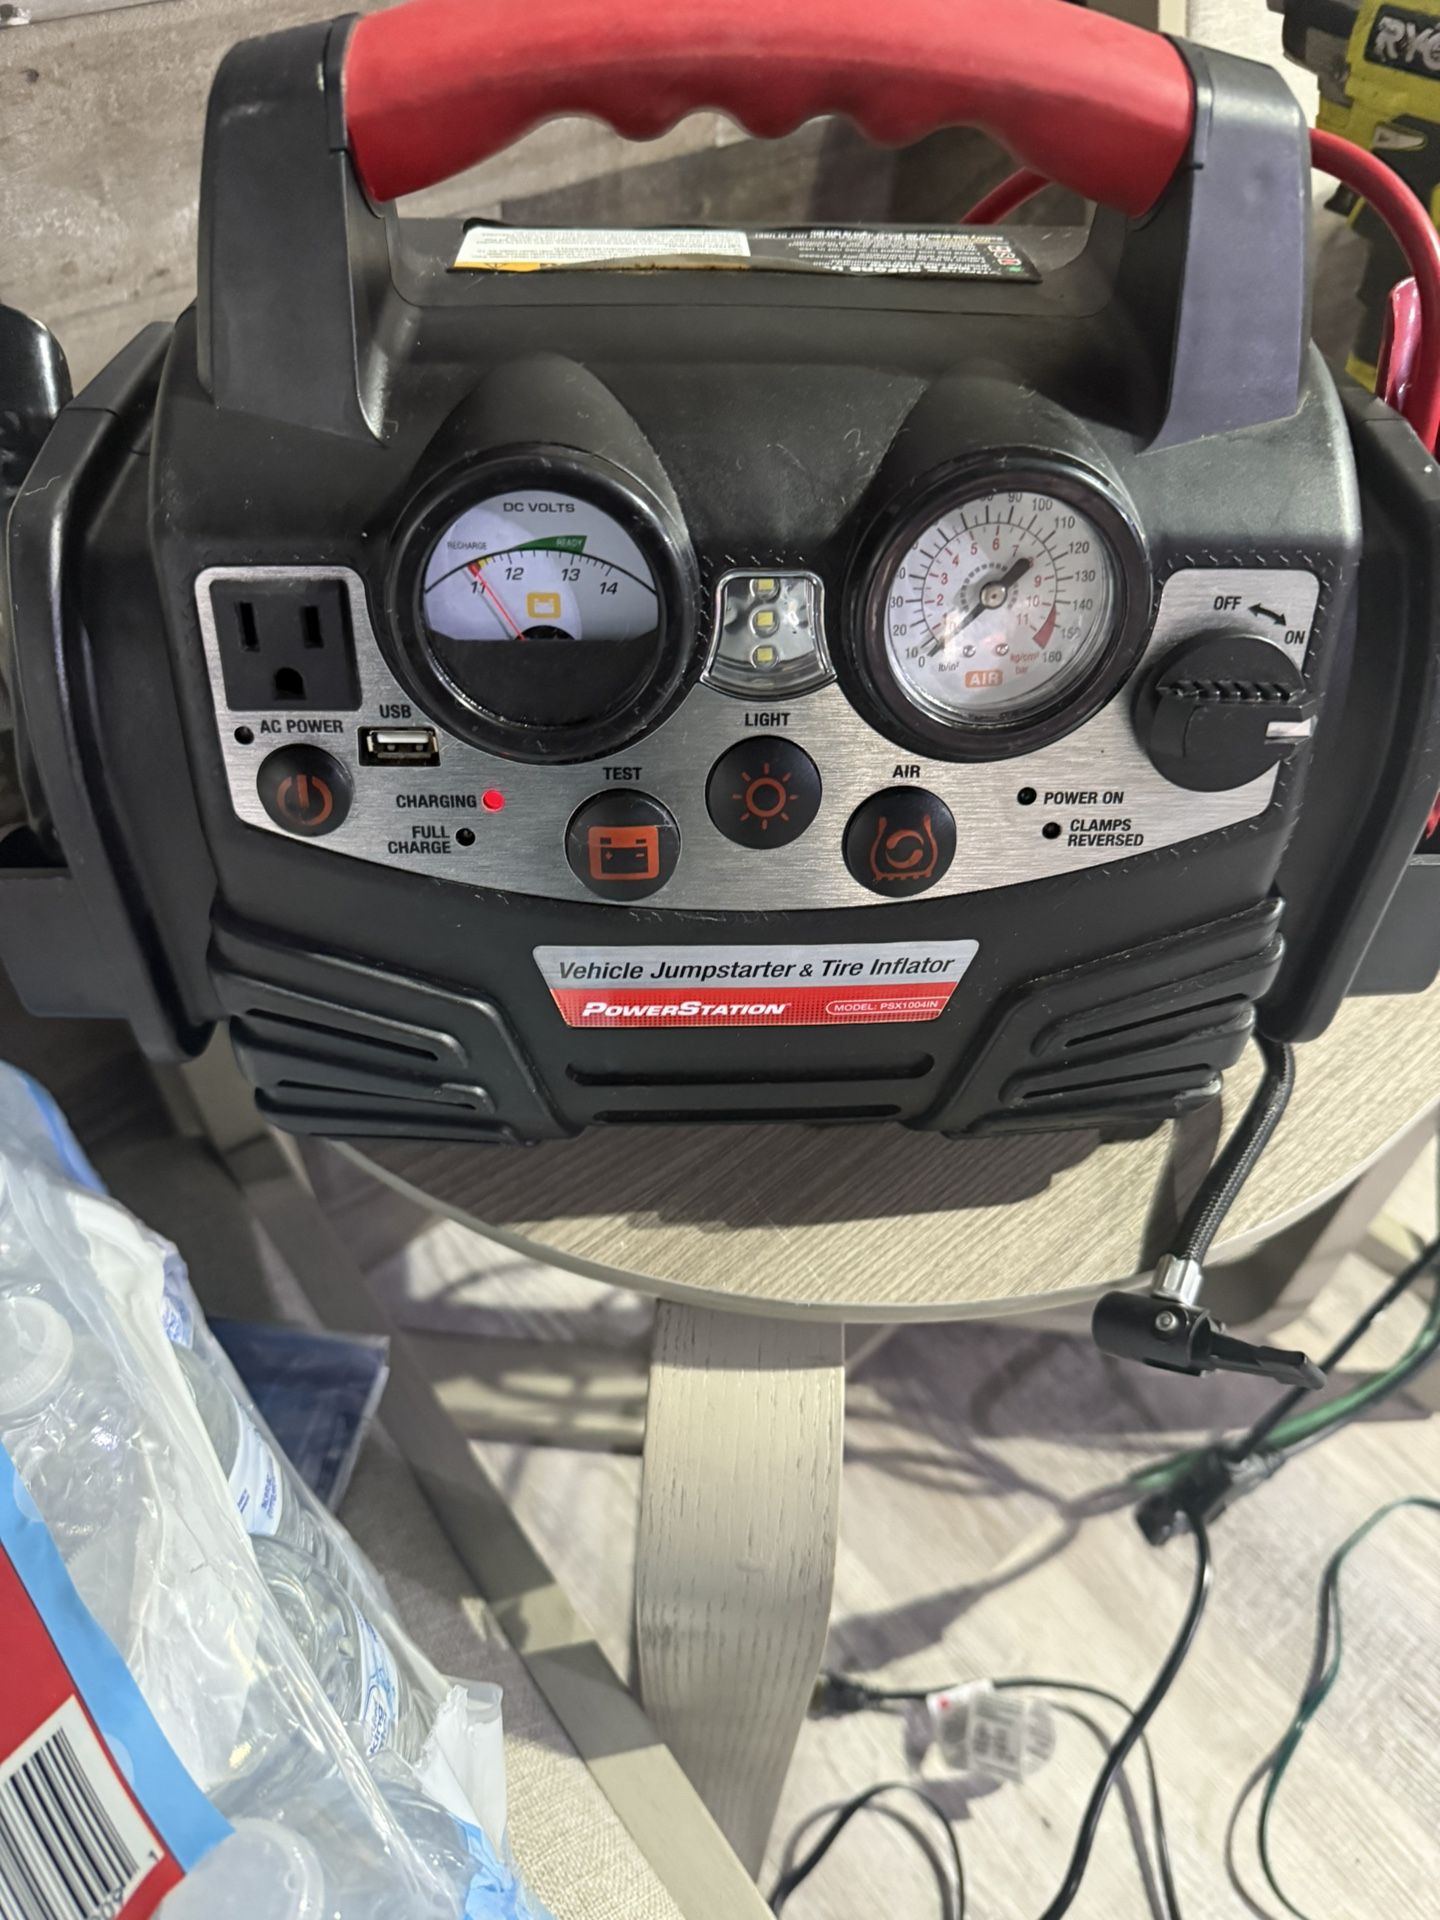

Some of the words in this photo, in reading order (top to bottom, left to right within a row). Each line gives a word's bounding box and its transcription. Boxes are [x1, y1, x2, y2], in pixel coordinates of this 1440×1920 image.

[503, 502, 524, 513] DC
[529, 502, 575, 513] VOLTS
[1033, 497, 1053, 511] 100
[1055, 515, 1075, 529] 110
[447, 541, 487, 550] RECHARGE
[556, 537, 583, 547] READY
[970, 542, 978, 555] 5
[992, 538, 1000, 551] 6
[1069, 541, 1090, 554] 120
[1012, 545, 1019, 557] 7
[952, 554, 960, 568] 4
[505, 567, 524, 580] 12
[561, 568, 580, 581] 13
[941, 572, 948, 585] 3
[1075, 570, 1096, 582] 130
[471, 581, 486, 594] 11
[1034, 575, 1042, 587] 9
[599, 582, 618, 595] 14
[890, 596, 904, 608] 30
[937, 594, 944, 606] 2
[1027, 595, 1040, 607] 10
[1073, 599, 1093, 611] 140
[1213, 596, 1242, 611] OFF
[1017, 613, 1029, 625] 11
[893, 624, 907, 636] 20
[1061, 626, 1081, 640] 150
[1284, 630, 1305, 645] ON
[905, 647, 919, 659] 10
[1042, 651, 1062, 663] 160
[918, 656, 926, 668] 0
[970, 672, 1000, 686] AIR
[379, 704, 412, 720] USB
[744, 712, 791, 727] LIGHT
[260, 721, 281, 734] AC
[286, 719, 344, 734] POWER
[603, 767, 642, 781] TEST
[892, 764, 921, 779] AIR
[395, 794, 477, 809] CHARGING
[1043, 791, 1098, 805] POWER
[1102, 791, 1125, 805] ON
[1070, 818, 1132, 832] CLAMPS
[412, 825, 450, 839] FULL
[1067, 833, 1144, 847] REVERSED
[387, 840, 452, 855] CHARGE
[559, 961, 643, 980] Vehicle
[650, 961, 796, 982] Jumpstarter
[799, 963, 813, 977] &
[822, 959, 864, 977] Tire
[869, 956, 956, 976] Inflator
[879, 1000, 938, 1010] PSX1004IN
